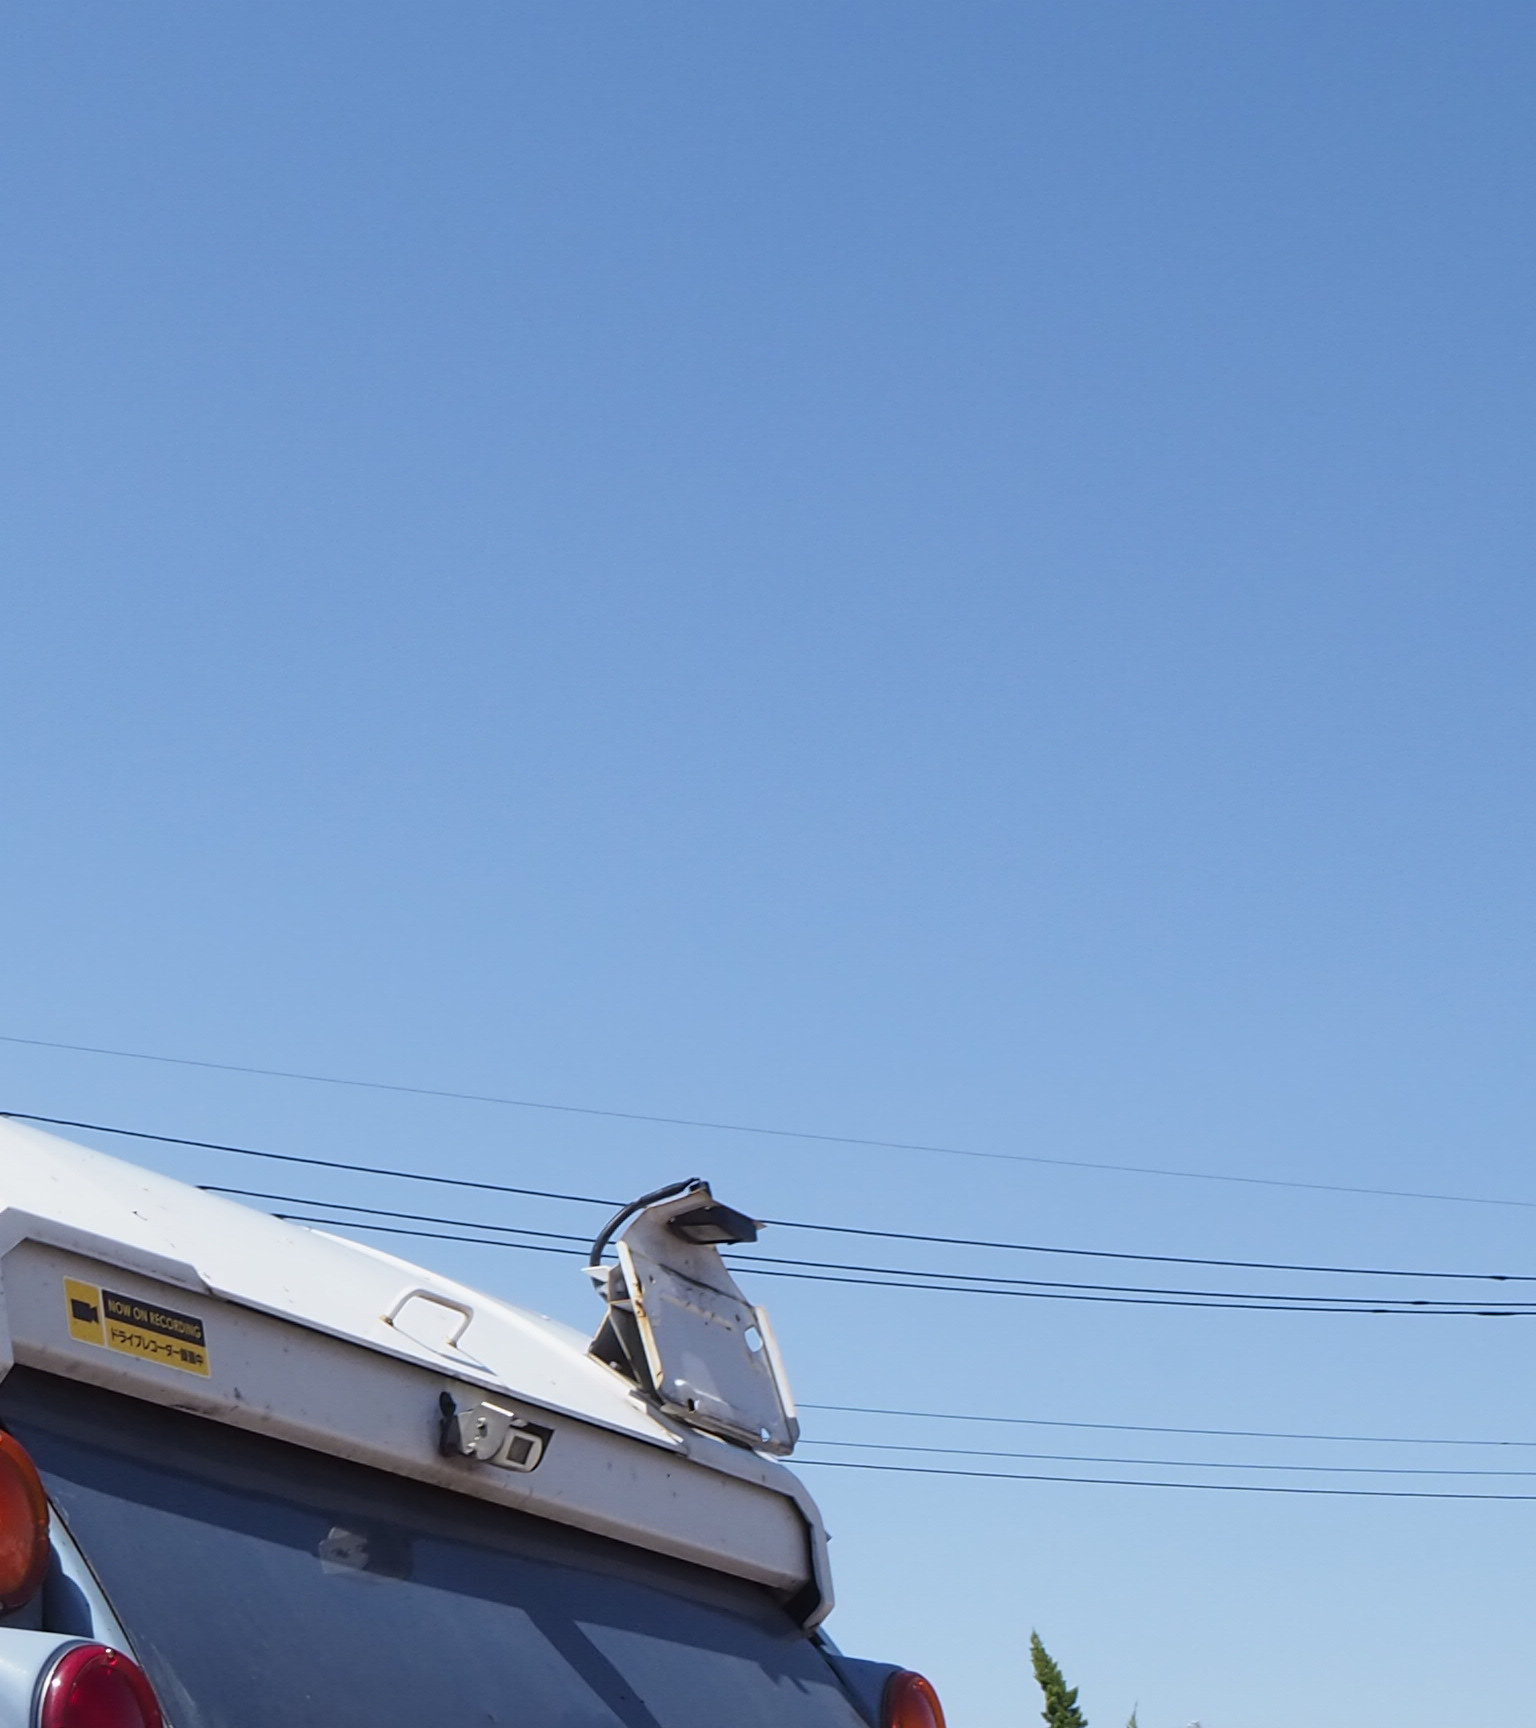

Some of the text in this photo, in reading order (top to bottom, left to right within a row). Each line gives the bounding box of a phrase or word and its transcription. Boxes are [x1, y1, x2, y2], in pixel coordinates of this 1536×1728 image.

[108, 1299, 201, 1338] NOW ON RECORDING
